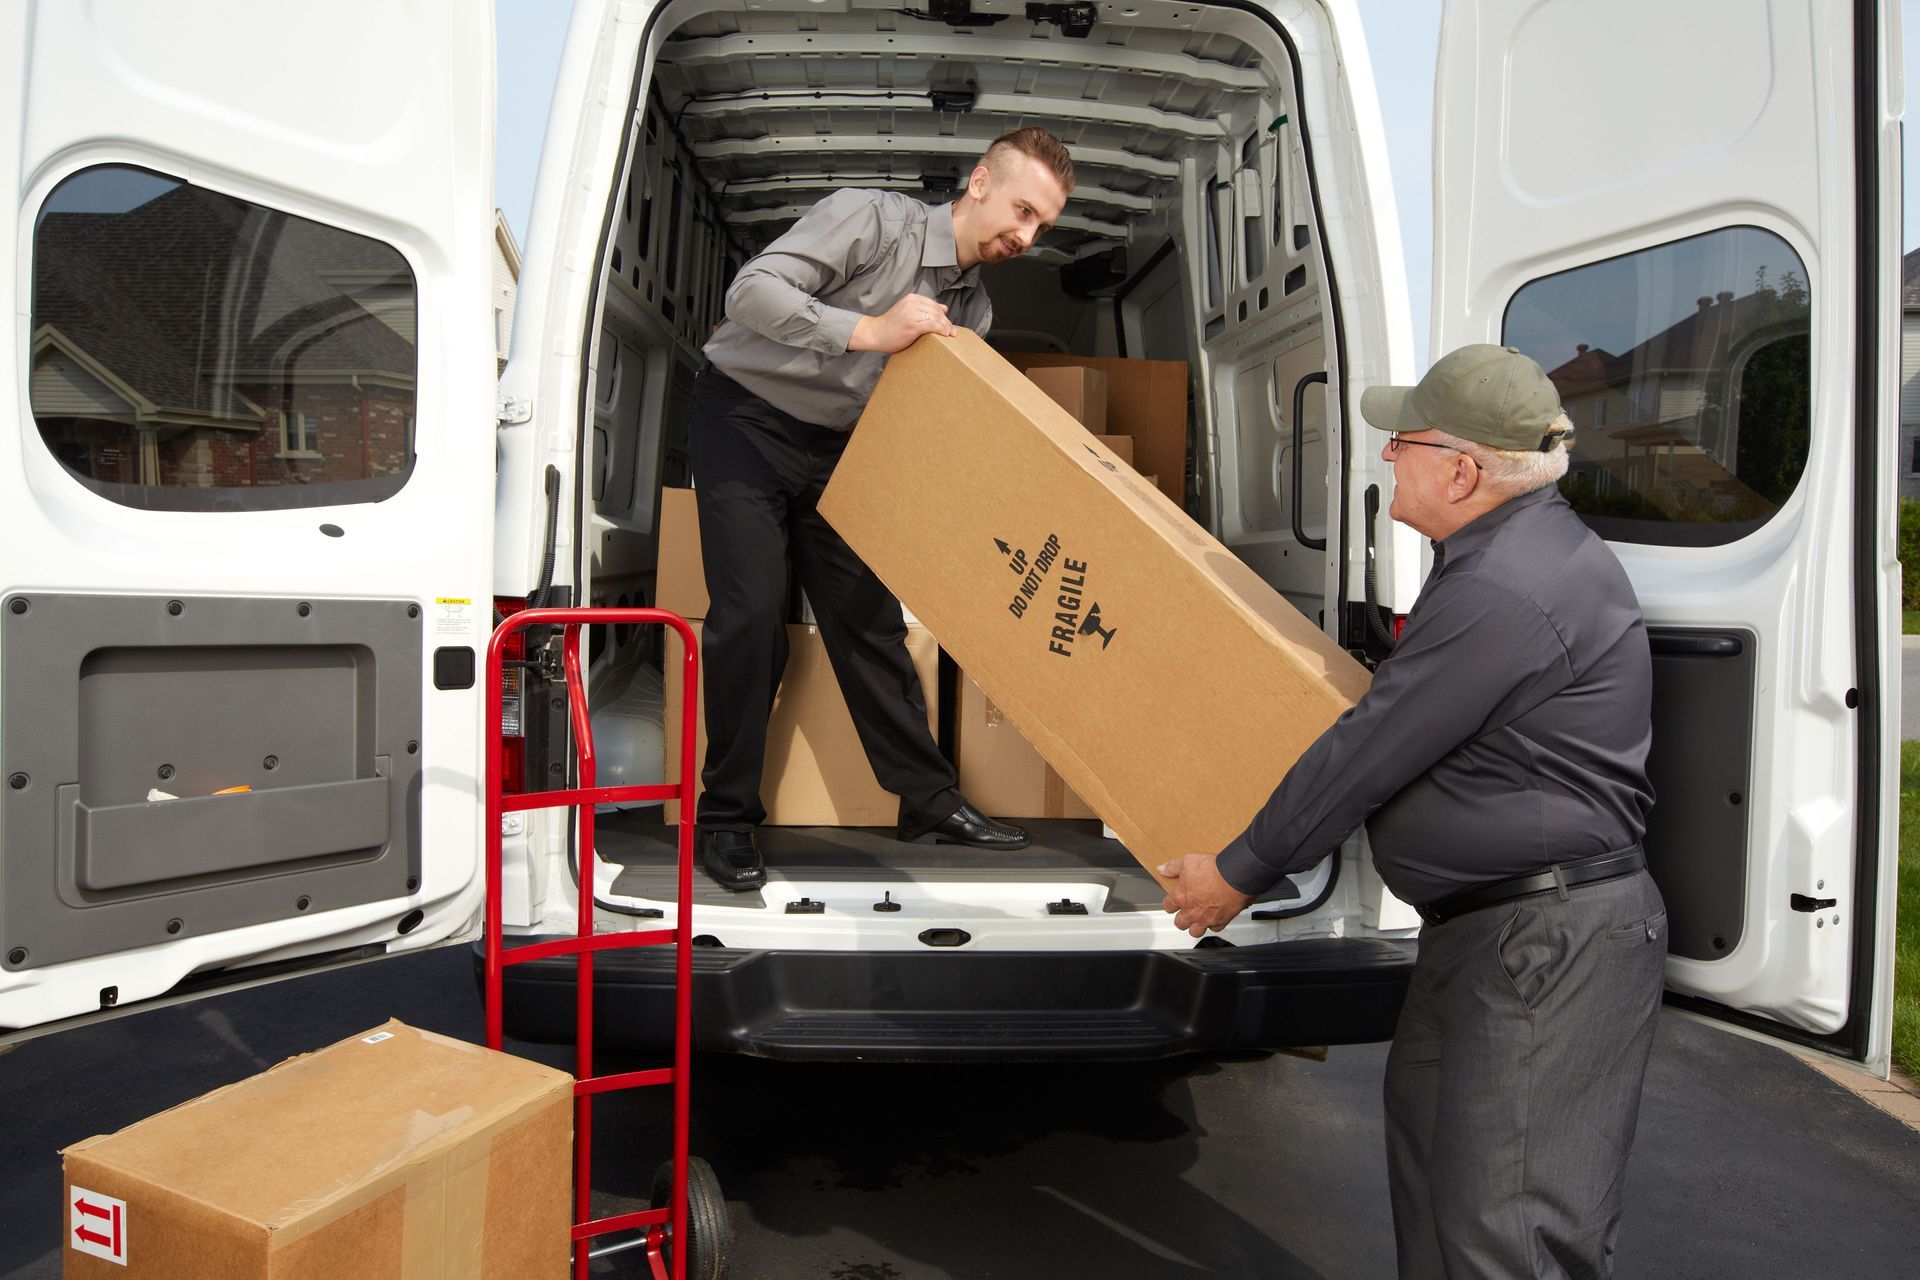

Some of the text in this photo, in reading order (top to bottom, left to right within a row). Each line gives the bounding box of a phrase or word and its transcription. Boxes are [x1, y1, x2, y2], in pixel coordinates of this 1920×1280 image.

[1008, 549, 1028, 576] UP
[1008, 533, 1061, 620] DO NOT DROP
[1049, 557, 1087, 657] FRAGILE
